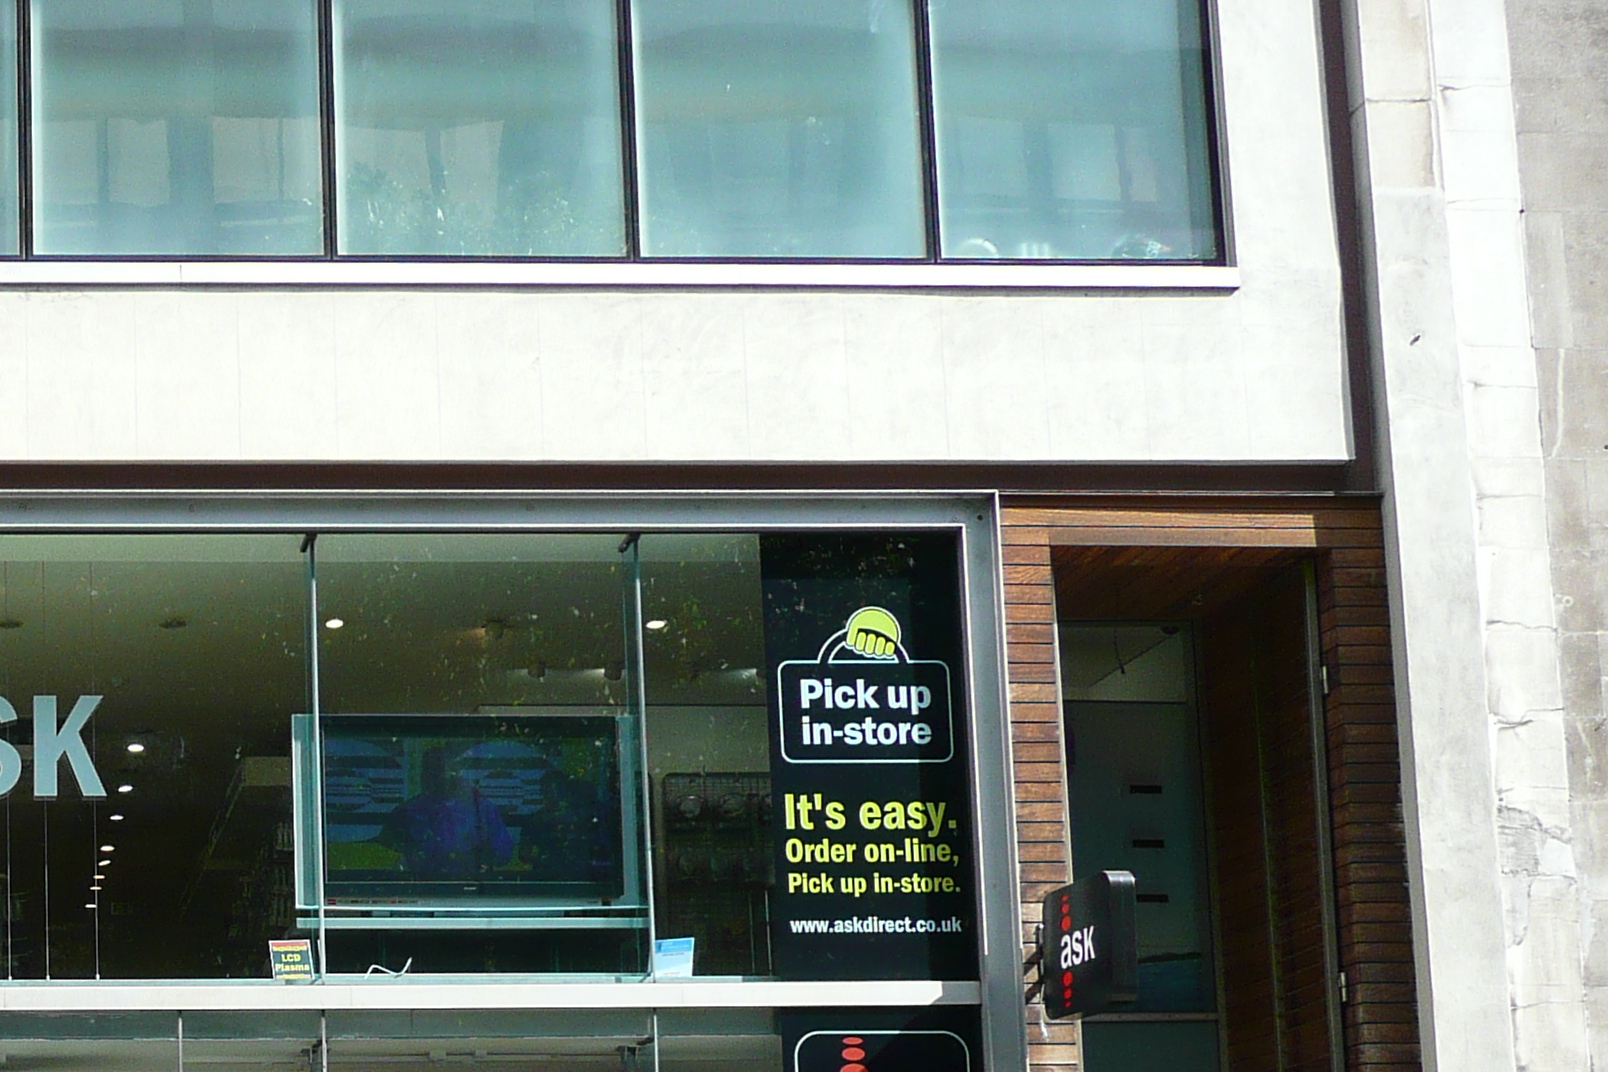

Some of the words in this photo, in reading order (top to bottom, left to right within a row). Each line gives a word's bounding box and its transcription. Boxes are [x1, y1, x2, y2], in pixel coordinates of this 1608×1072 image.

[800, 678, 880, 709] Pick
[887, 686, 931, 715] up
[802, 716, 931, 745] in-store
[784, 793, 846, 830] It's
[859, 801, 956, 837] easy.
[786, 838, 856, 863] Order
[864, 838, 958, 865] on-line,
[788, 873, 834, 893] Pick
[840, 877, 867, 897] up
[873, 872, 959, 893] in-store.
[790, 916, 961, 933] www.askdirect.co.uk
[281, 954, 301, 962] LCD
[1060, 924, 1096, 969] ask
[275, 963, 310, 972] Plasma
